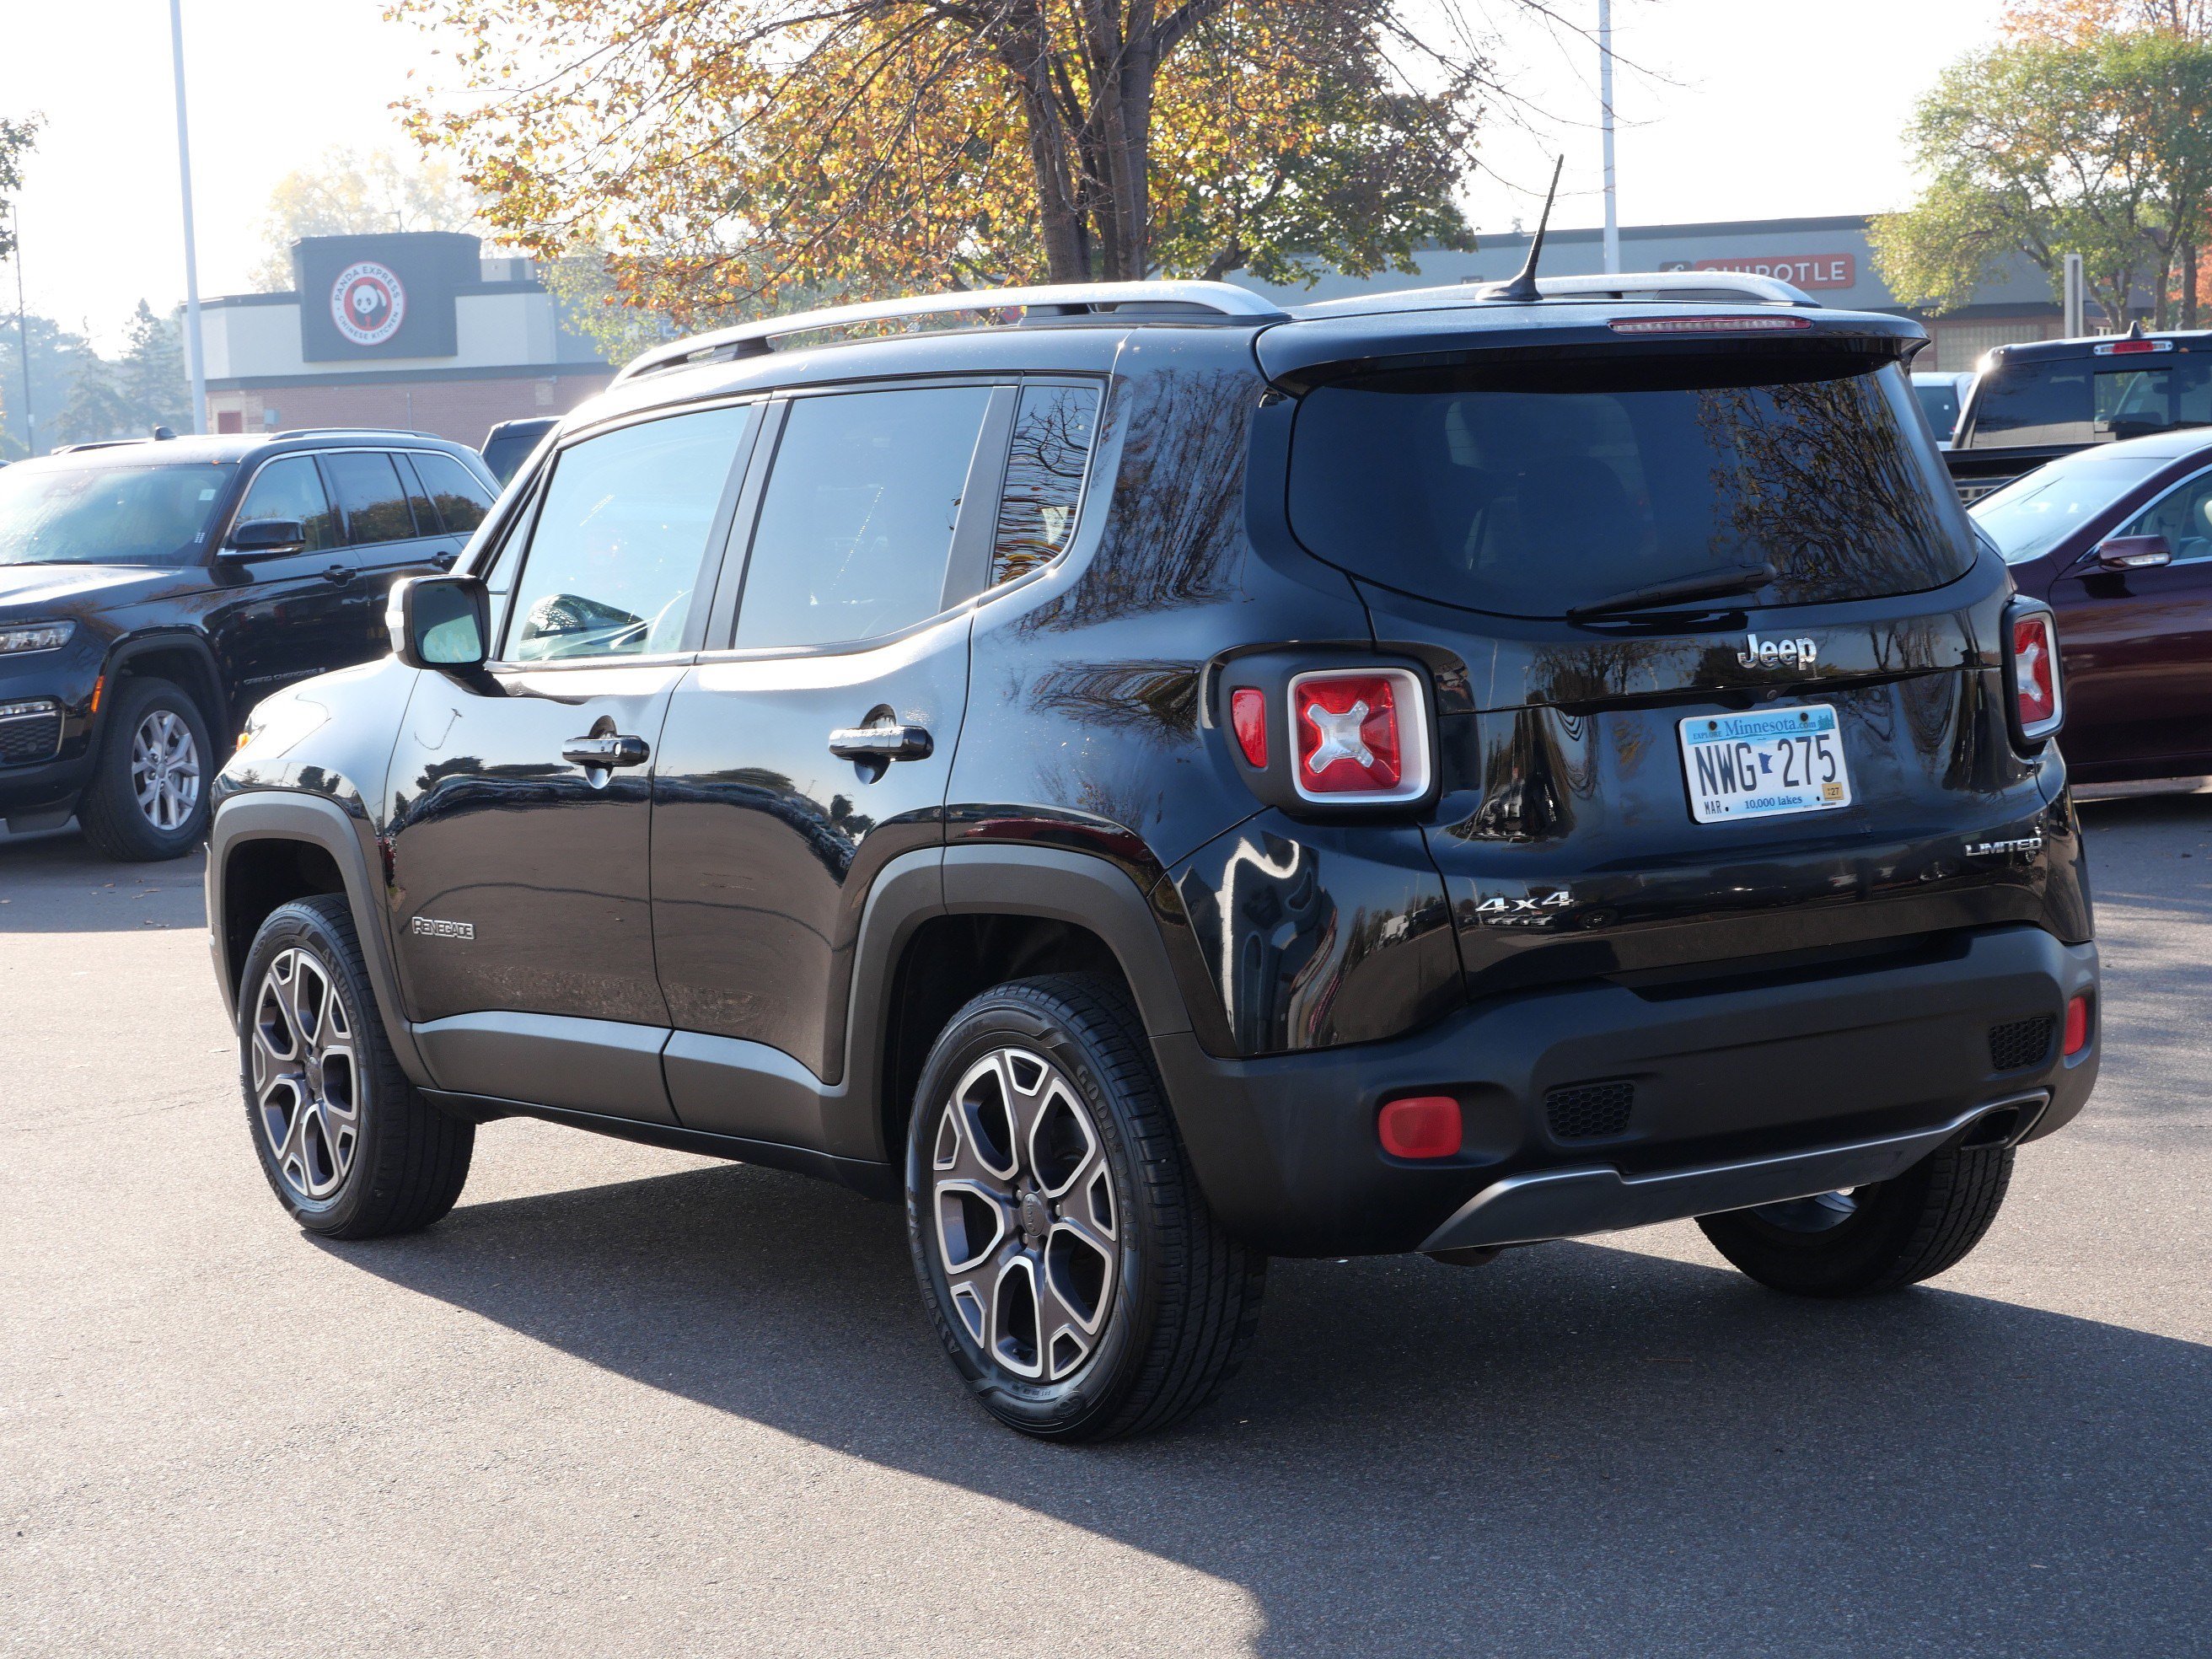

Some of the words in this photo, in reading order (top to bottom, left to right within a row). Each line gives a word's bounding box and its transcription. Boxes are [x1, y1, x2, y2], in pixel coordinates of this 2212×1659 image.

[335, 269, 360, 302] PANDA
[362, 266, 400, 299] EXPRESS
[338, 315, 368, 340] CHINESE
[371, 312, 399, 340] KITCHEN
[1737, 634, 1817, 671] Jeep
[1694, 731, 1722, 740] EXPLORE
[1694, 742, 1758, 797] NWG
[1778, 734, 1836, 787] 275
[1705, 800, 1722, 815] MAR
[1744, 797, 1775, 809] 10,000
[1778, 794, 1802, 807] lakes
[1964, 837, 2043, 856] LIMITED
[1475, 891, 1574, 914] 4x4
[411, 916, 476, 940] RENEGADE
